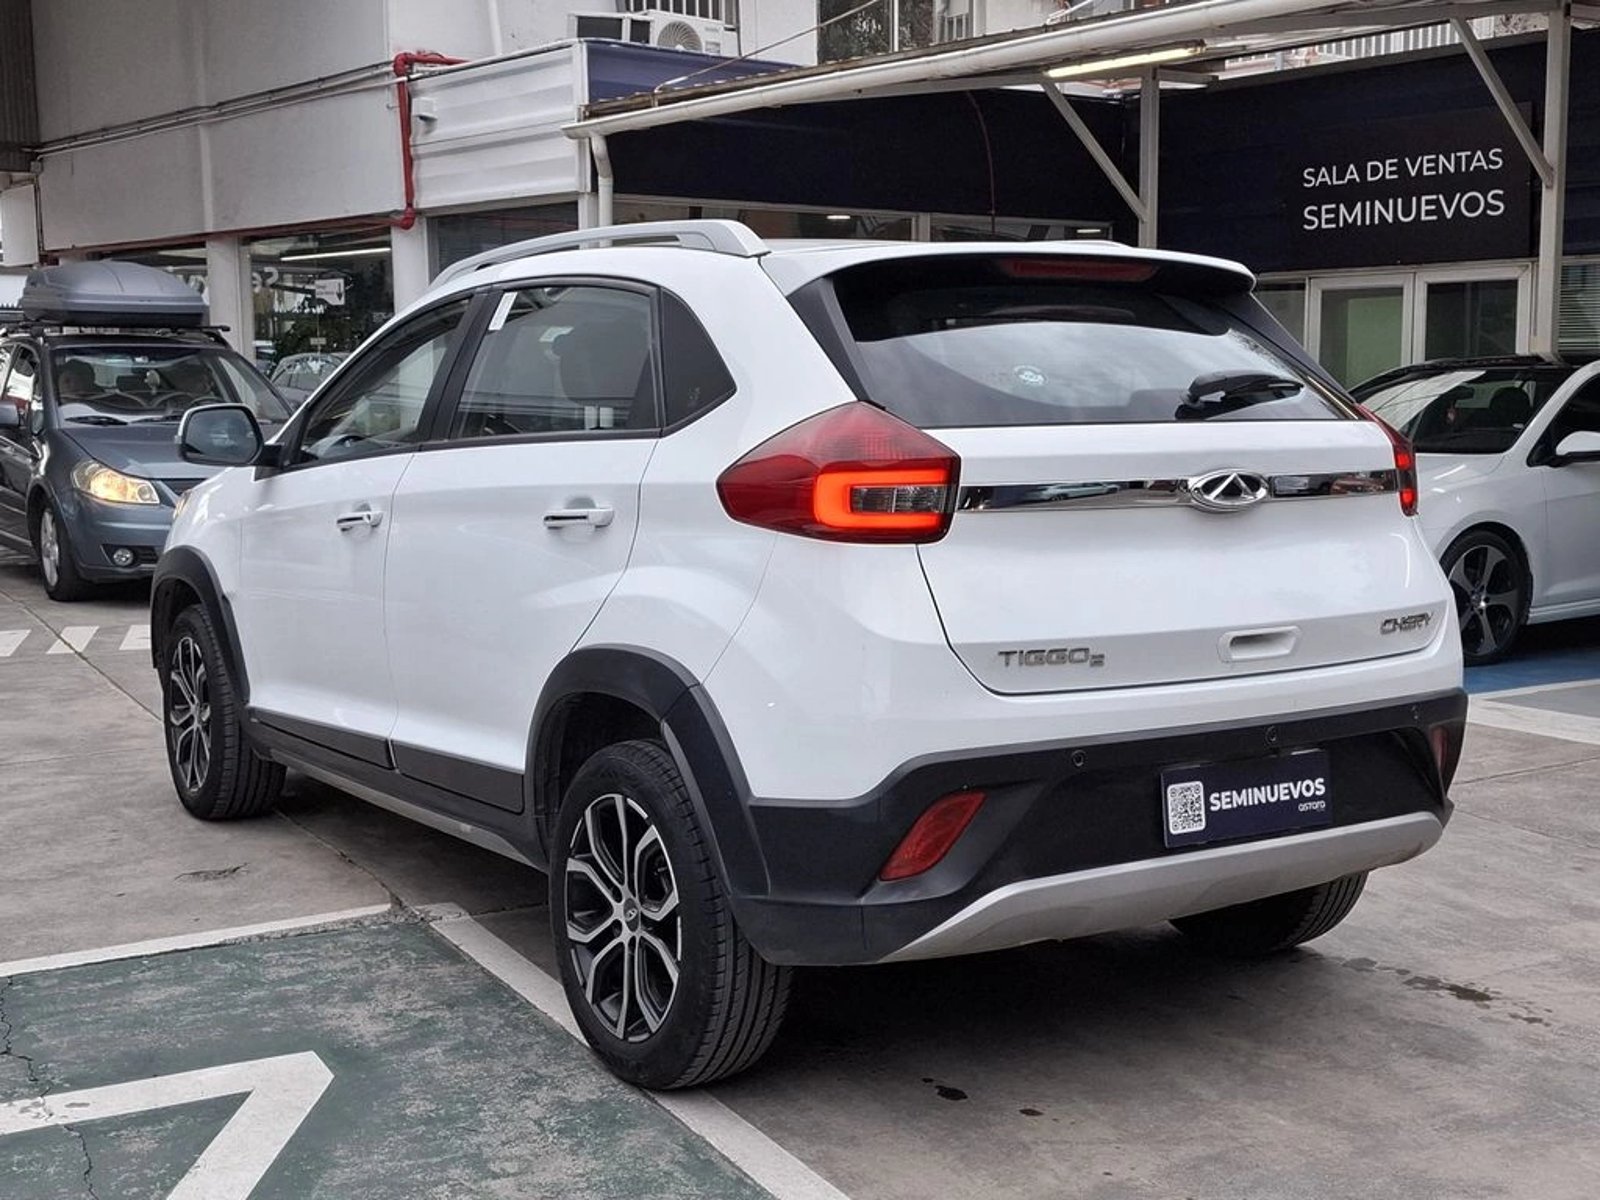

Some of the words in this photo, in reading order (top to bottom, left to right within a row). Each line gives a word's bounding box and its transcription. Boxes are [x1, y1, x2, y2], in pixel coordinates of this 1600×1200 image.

[1302, 163, 1361, 188] SALA
[1366, 157, 1399, 182] DE
[1404, 148, 1505, 178] VENTAS
[1302, 189, 1506, 231] SEMINUEVOS
[1209, 777, 1326, 812] SEMINUEVOS
